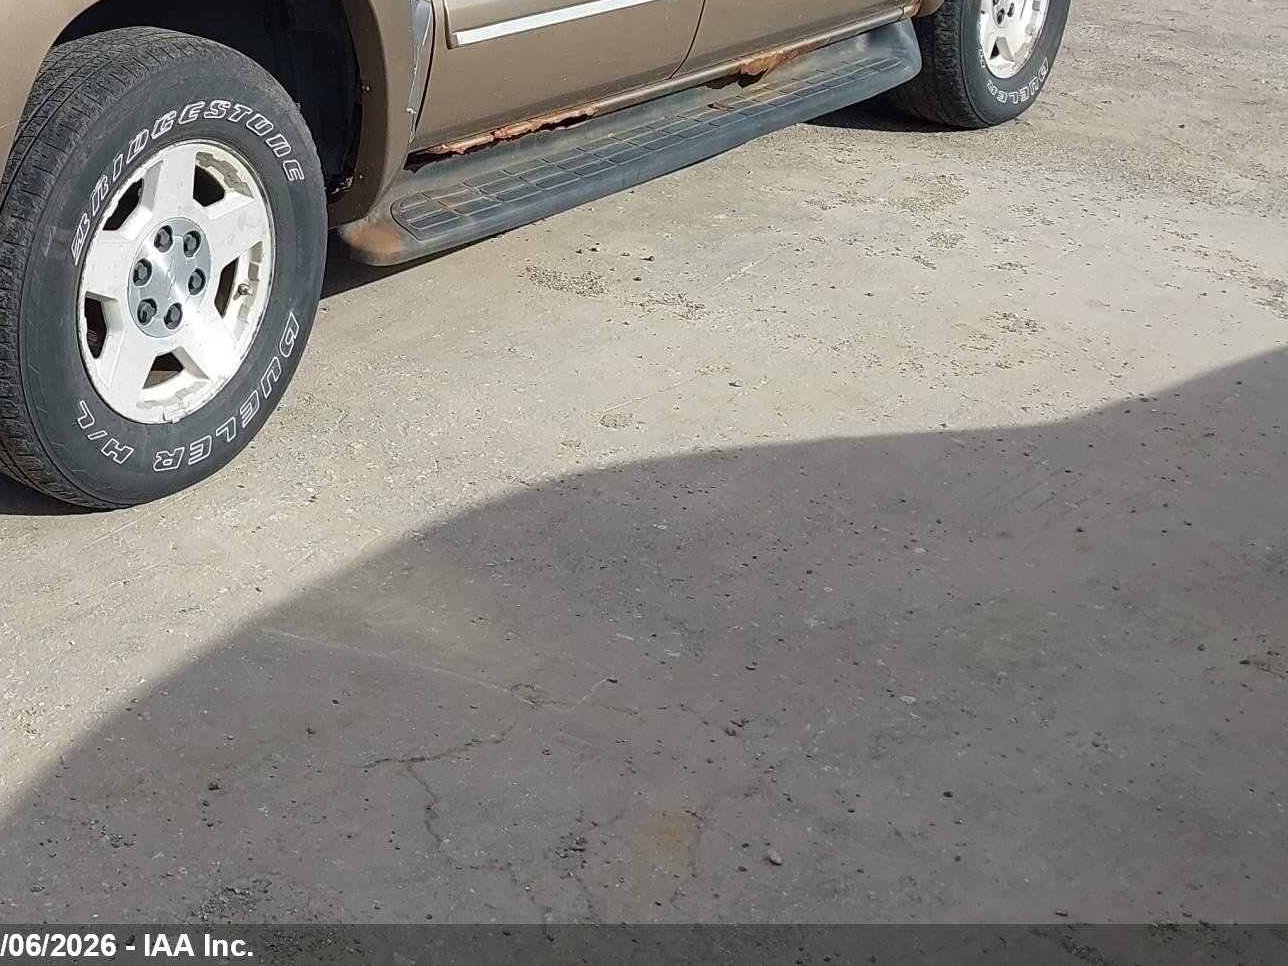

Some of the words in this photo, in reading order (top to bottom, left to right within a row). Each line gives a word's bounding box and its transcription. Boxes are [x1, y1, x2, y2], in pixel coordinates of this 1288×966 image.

[986, 57, 1049, 105] DUELER
[70, 99, 305, 266] BRIDGESTONE
[73, 399, 134, 466] H/L
[153, 312, 300, 472] DUELER
